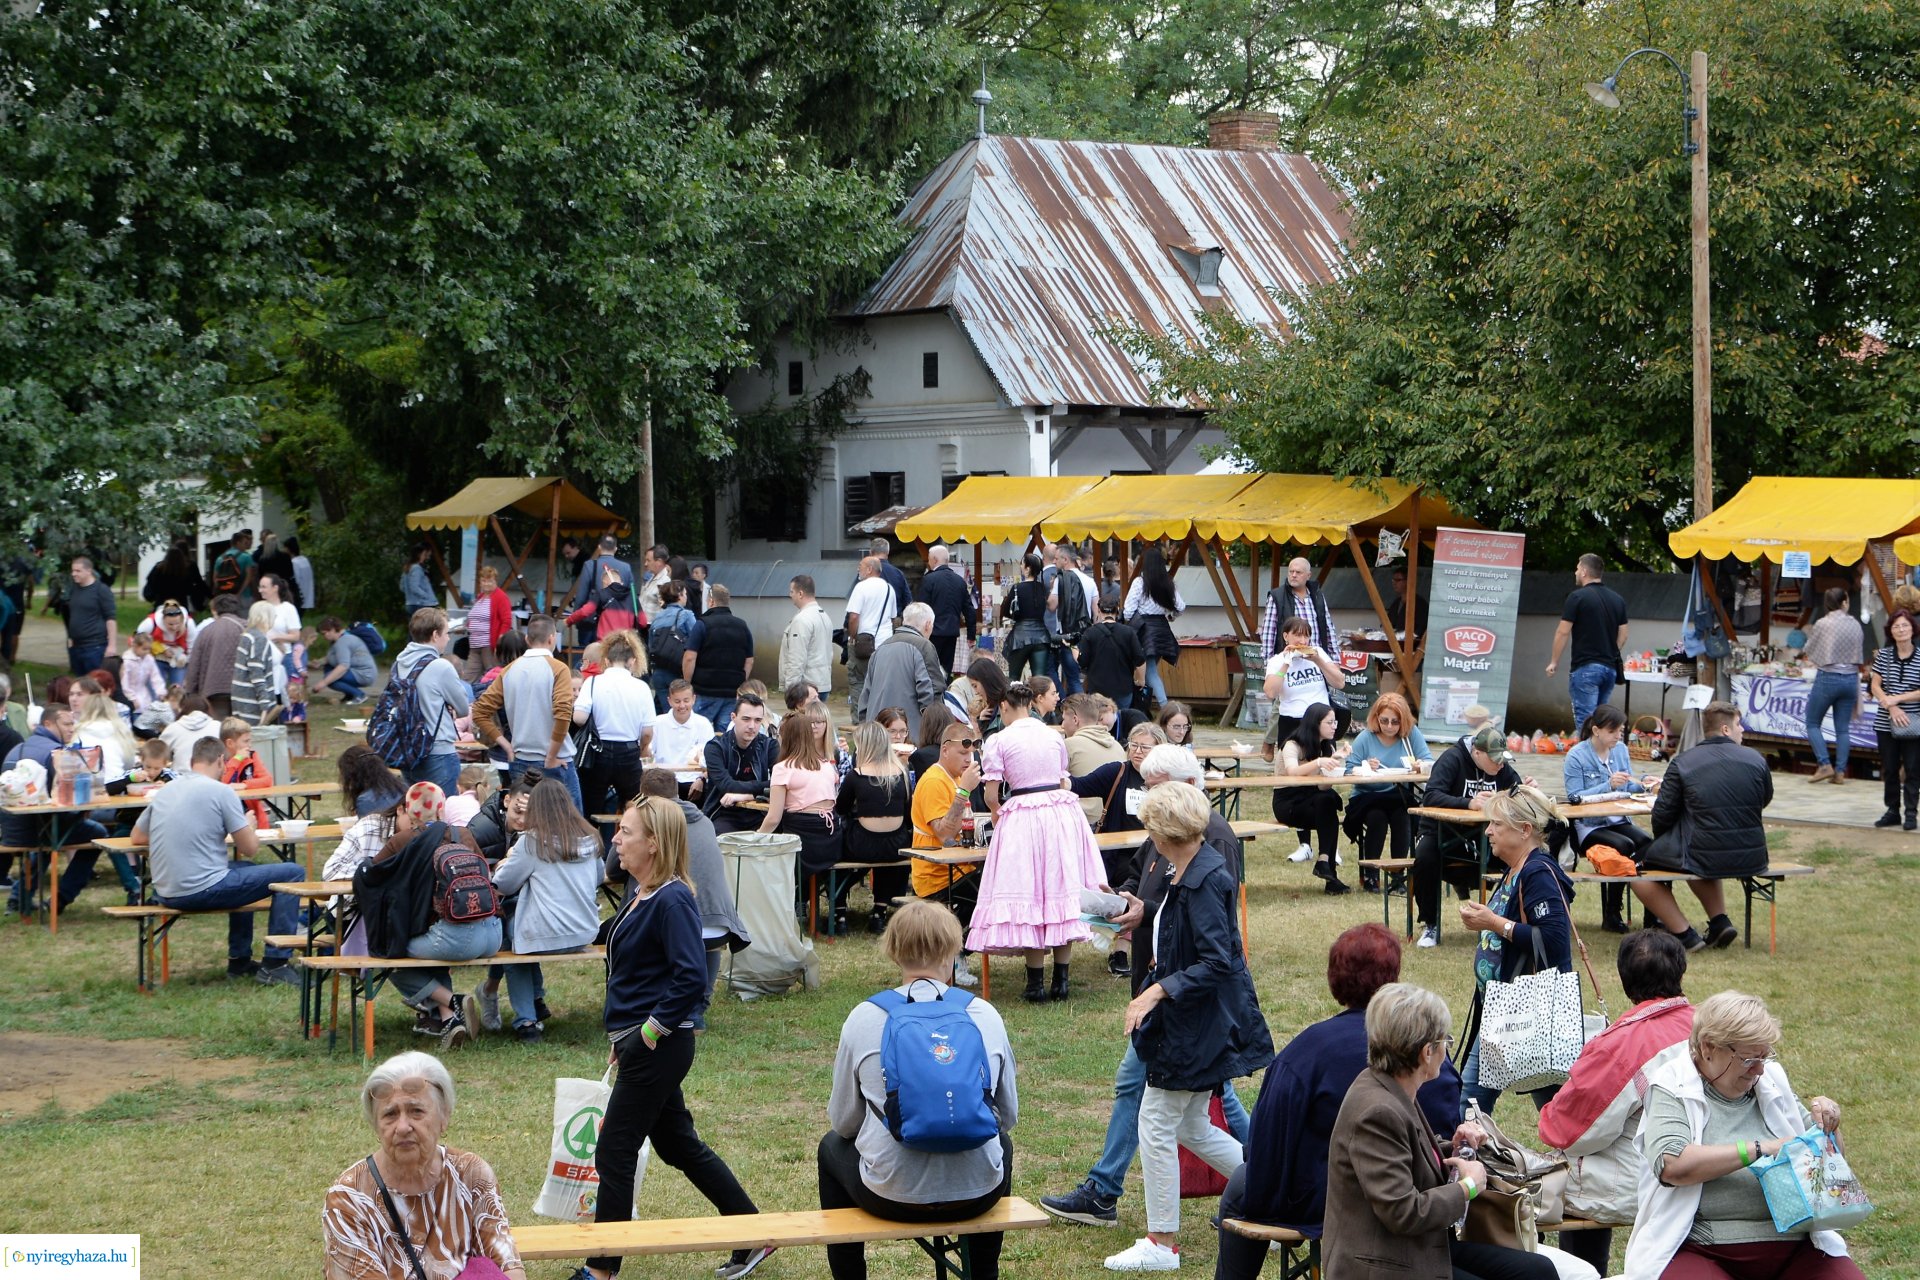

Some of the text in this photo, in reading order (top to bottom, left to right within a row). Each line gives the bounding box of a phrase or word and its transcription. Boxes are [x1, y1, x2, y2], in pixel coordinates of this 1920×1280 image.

[1444, 568, 1468, 576] száraz
[1447, 581, 1473, 590] reform
[1447, 595, 1500, 605] magyar babok
[1449, 606, 1461, 614] bio
[1455, 631, 1487, 642] PACO
[1443, 656, 1491, 672] Magtár
[1287, 666, 1321, 682] KARL
[1345, 673, 1368, 686] agtár
[1749, 679, 1806, 716] Omn
[566, 1166, 600, 1181] SPA
